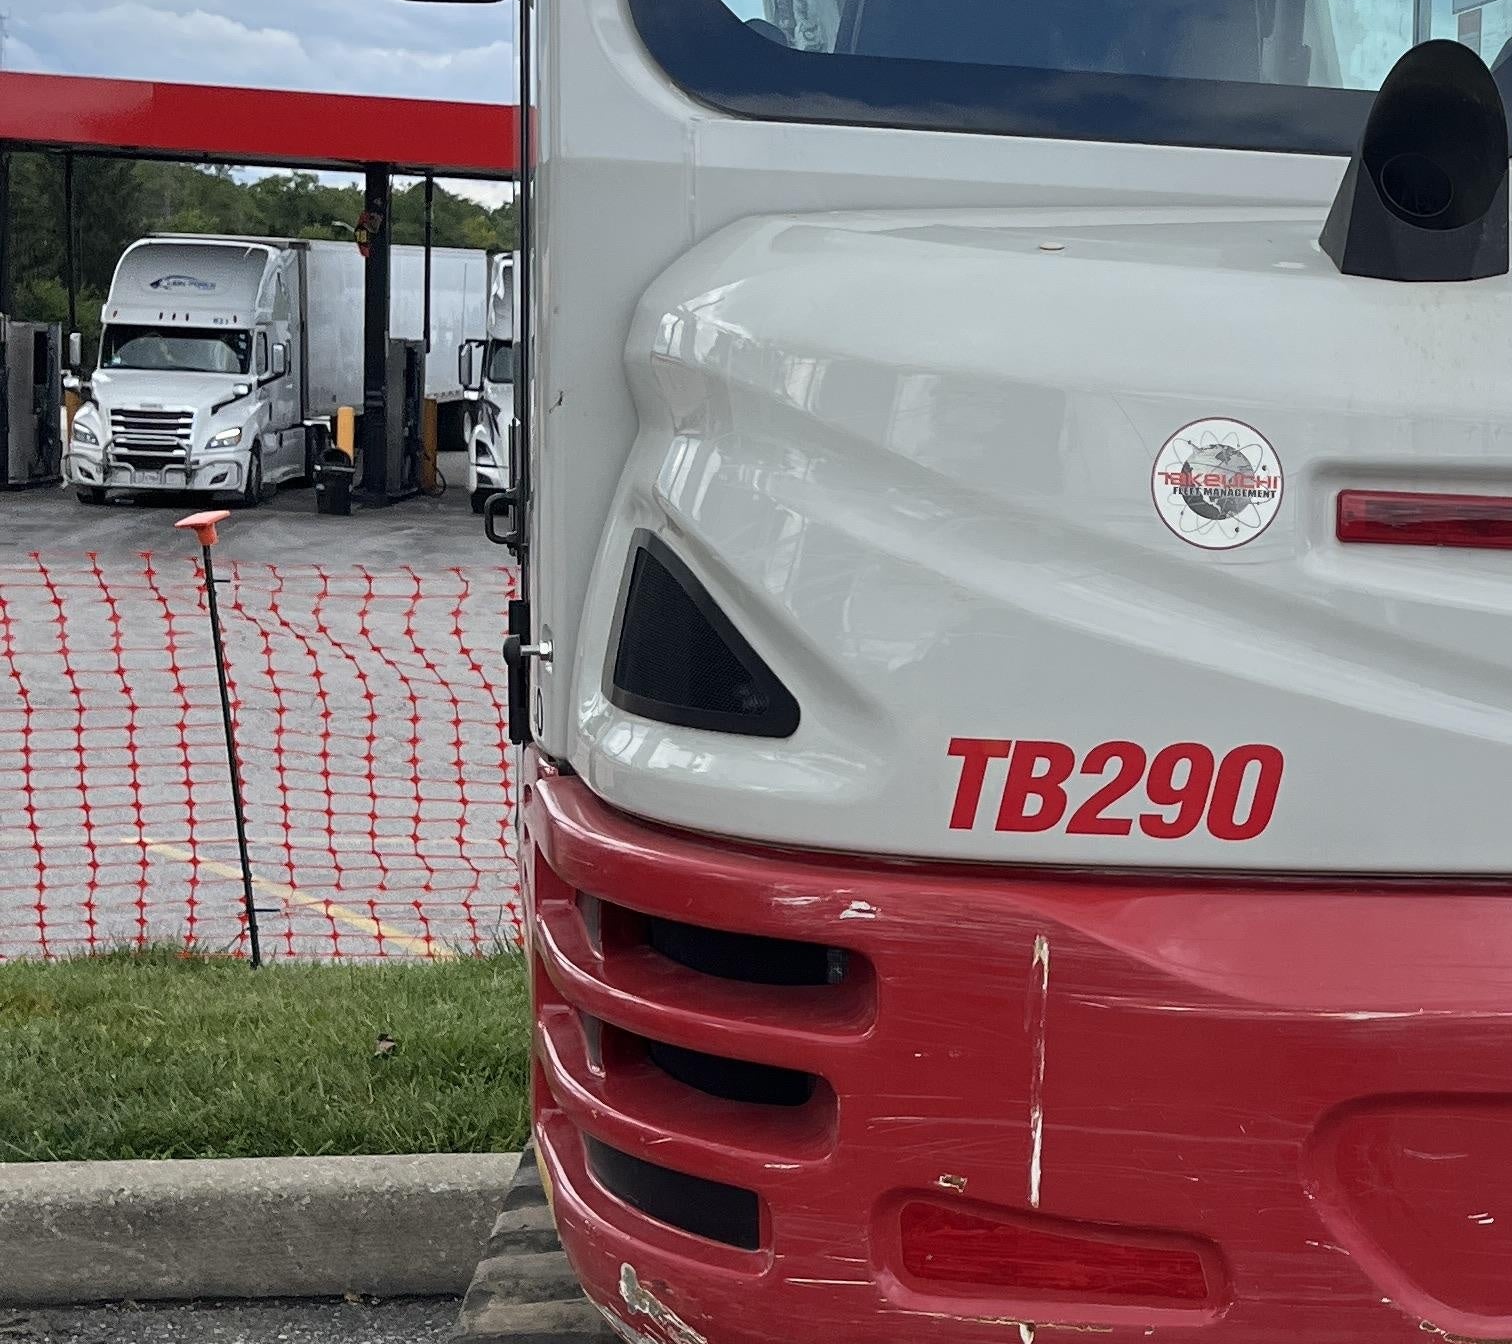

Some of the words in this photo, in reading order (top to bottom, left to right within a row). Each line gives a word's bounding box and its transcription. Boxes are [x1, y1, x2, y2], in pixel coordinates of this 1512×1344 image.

[1173, 486, 1201, 496] FLEET
[1203, 487, 1277, 498] MANAGEMENT
[947, 737, 1285, 841] TB290
